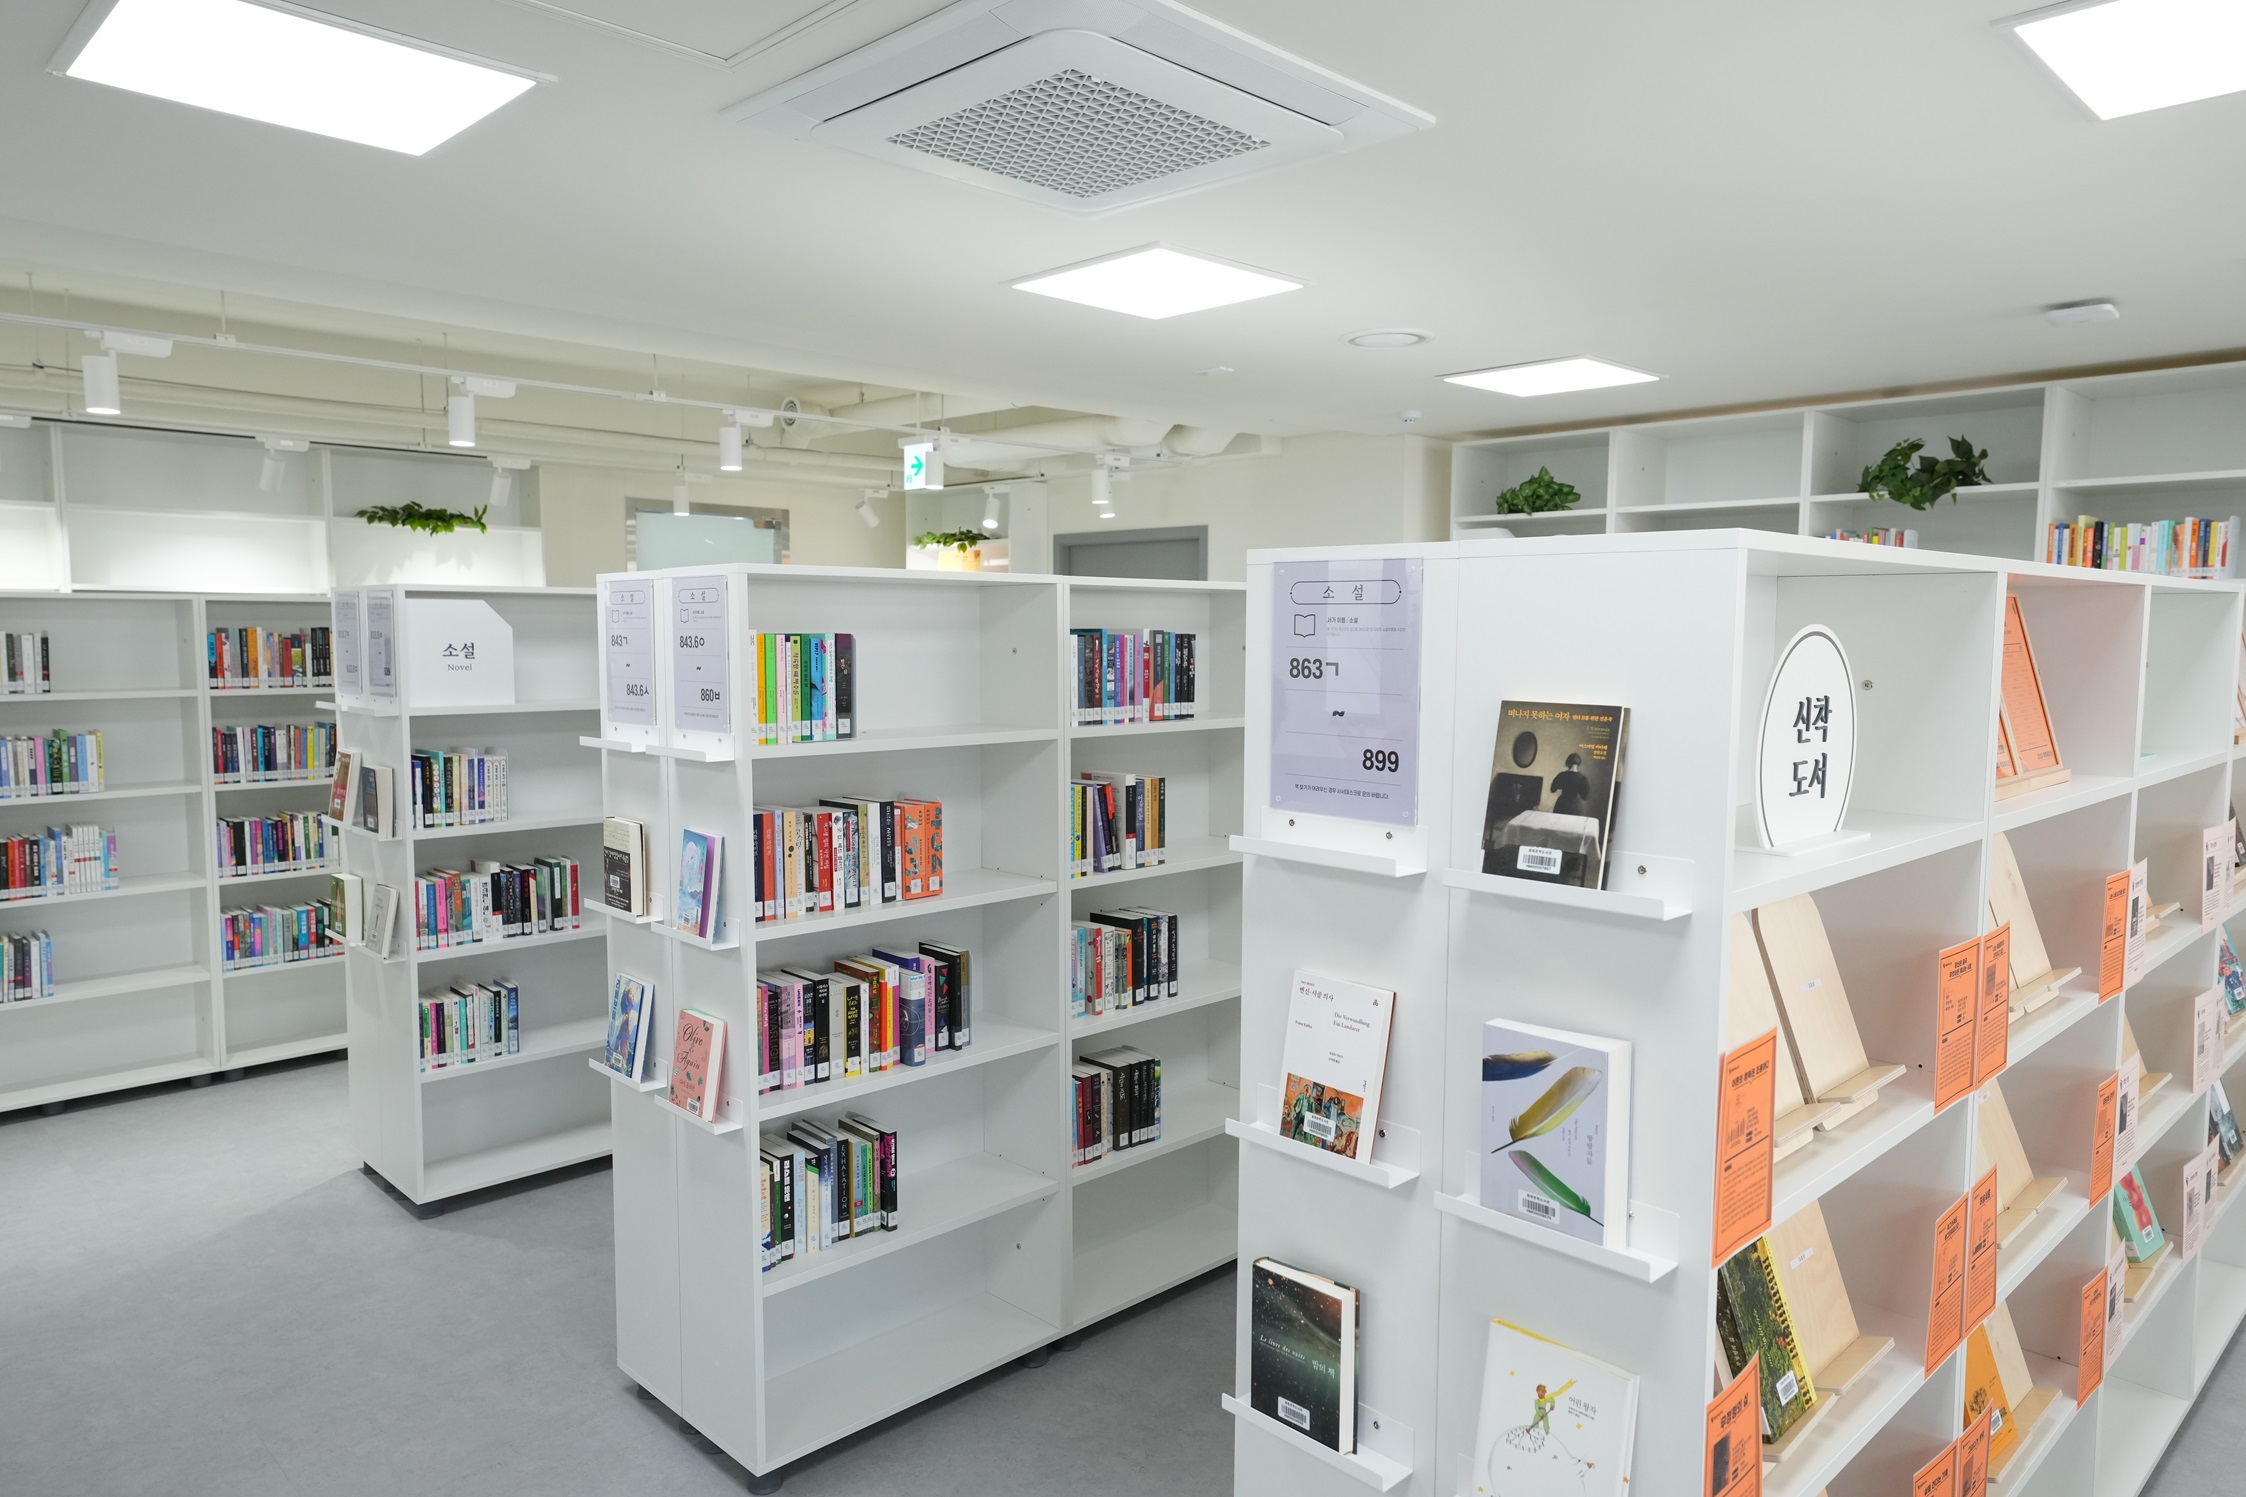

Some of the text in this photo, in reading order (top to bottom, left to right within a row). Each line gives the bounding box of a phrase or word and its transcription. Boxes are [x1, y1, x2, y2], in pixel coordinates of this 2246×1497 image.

[442, 642, 476, 660] 소설
[447, 663, 473, 671] Novel
[1554, 711, 1571, 722] 여자
[1793, 695, 1832, 743] 신착
[1362, 748, 1399, 773] 899
[1789, 752, 1828, 798] 도서
[1334, 1012, 1343, 1020] Die
[682, 1022, 704, 1047] Olive
[769, 1013, 778, 1070] WARLIGHT
[677, 1050, 700, 1070] Again
[840, 1144, 848, 1209] EXHALATION
[1312, 1359, 1335, 1379] 밤의 책
[1568, 1396, 1582, 1409] 어린
[1583, 1402, 1597, 1416] 왕자
[1742, 1392, 1749, 1408] 삶
